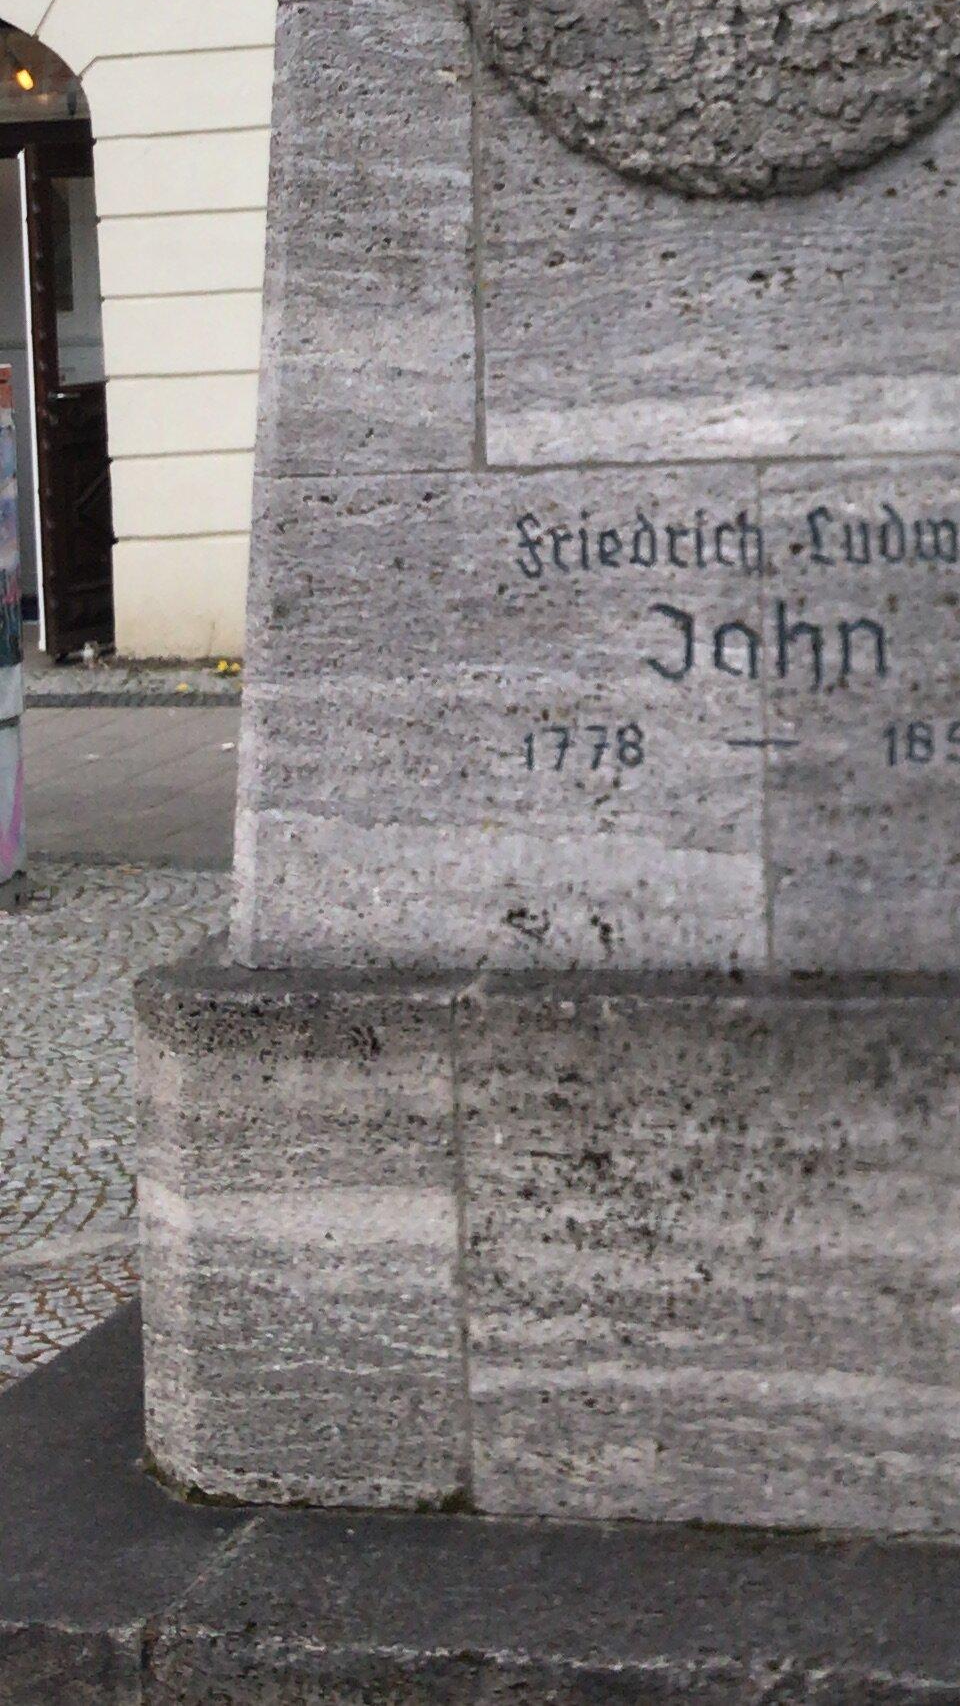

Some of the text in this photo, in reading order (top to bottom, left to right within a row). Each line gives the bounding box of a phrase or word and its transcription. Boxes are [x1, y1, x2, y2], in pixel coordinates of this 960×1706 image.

[516, 504, 764, 579] Friedrich
[645, 598, 888, 691] Jahn
[522, 721, 646, 771] 1778
